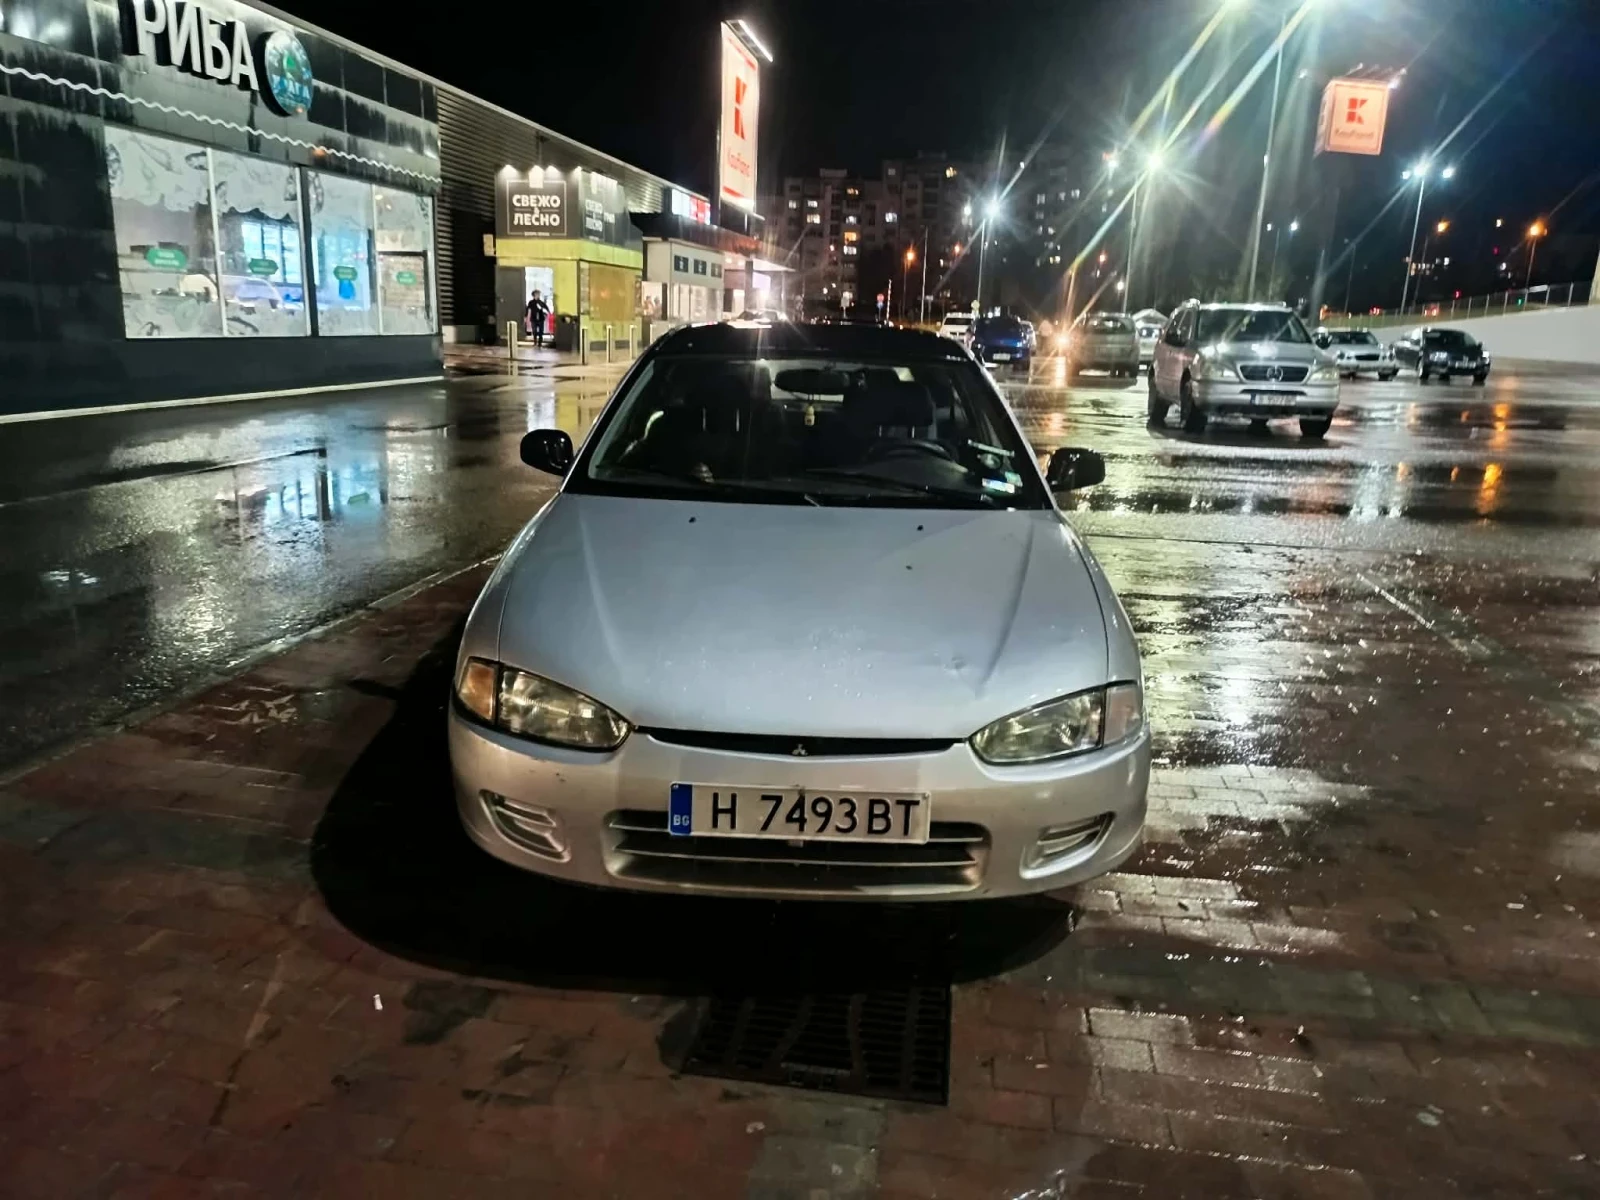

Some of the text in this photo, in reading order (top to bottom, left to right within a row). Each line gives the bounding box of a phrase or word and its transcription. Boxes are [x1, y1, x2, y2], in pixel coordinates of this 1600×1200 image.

[134, 0, 260, 91] РИБА
[512, 194, 561, 208] СВЕЖО
[513, 213, 560, 227] ЛЕСНО
[673, 814, 690, 827] BG
